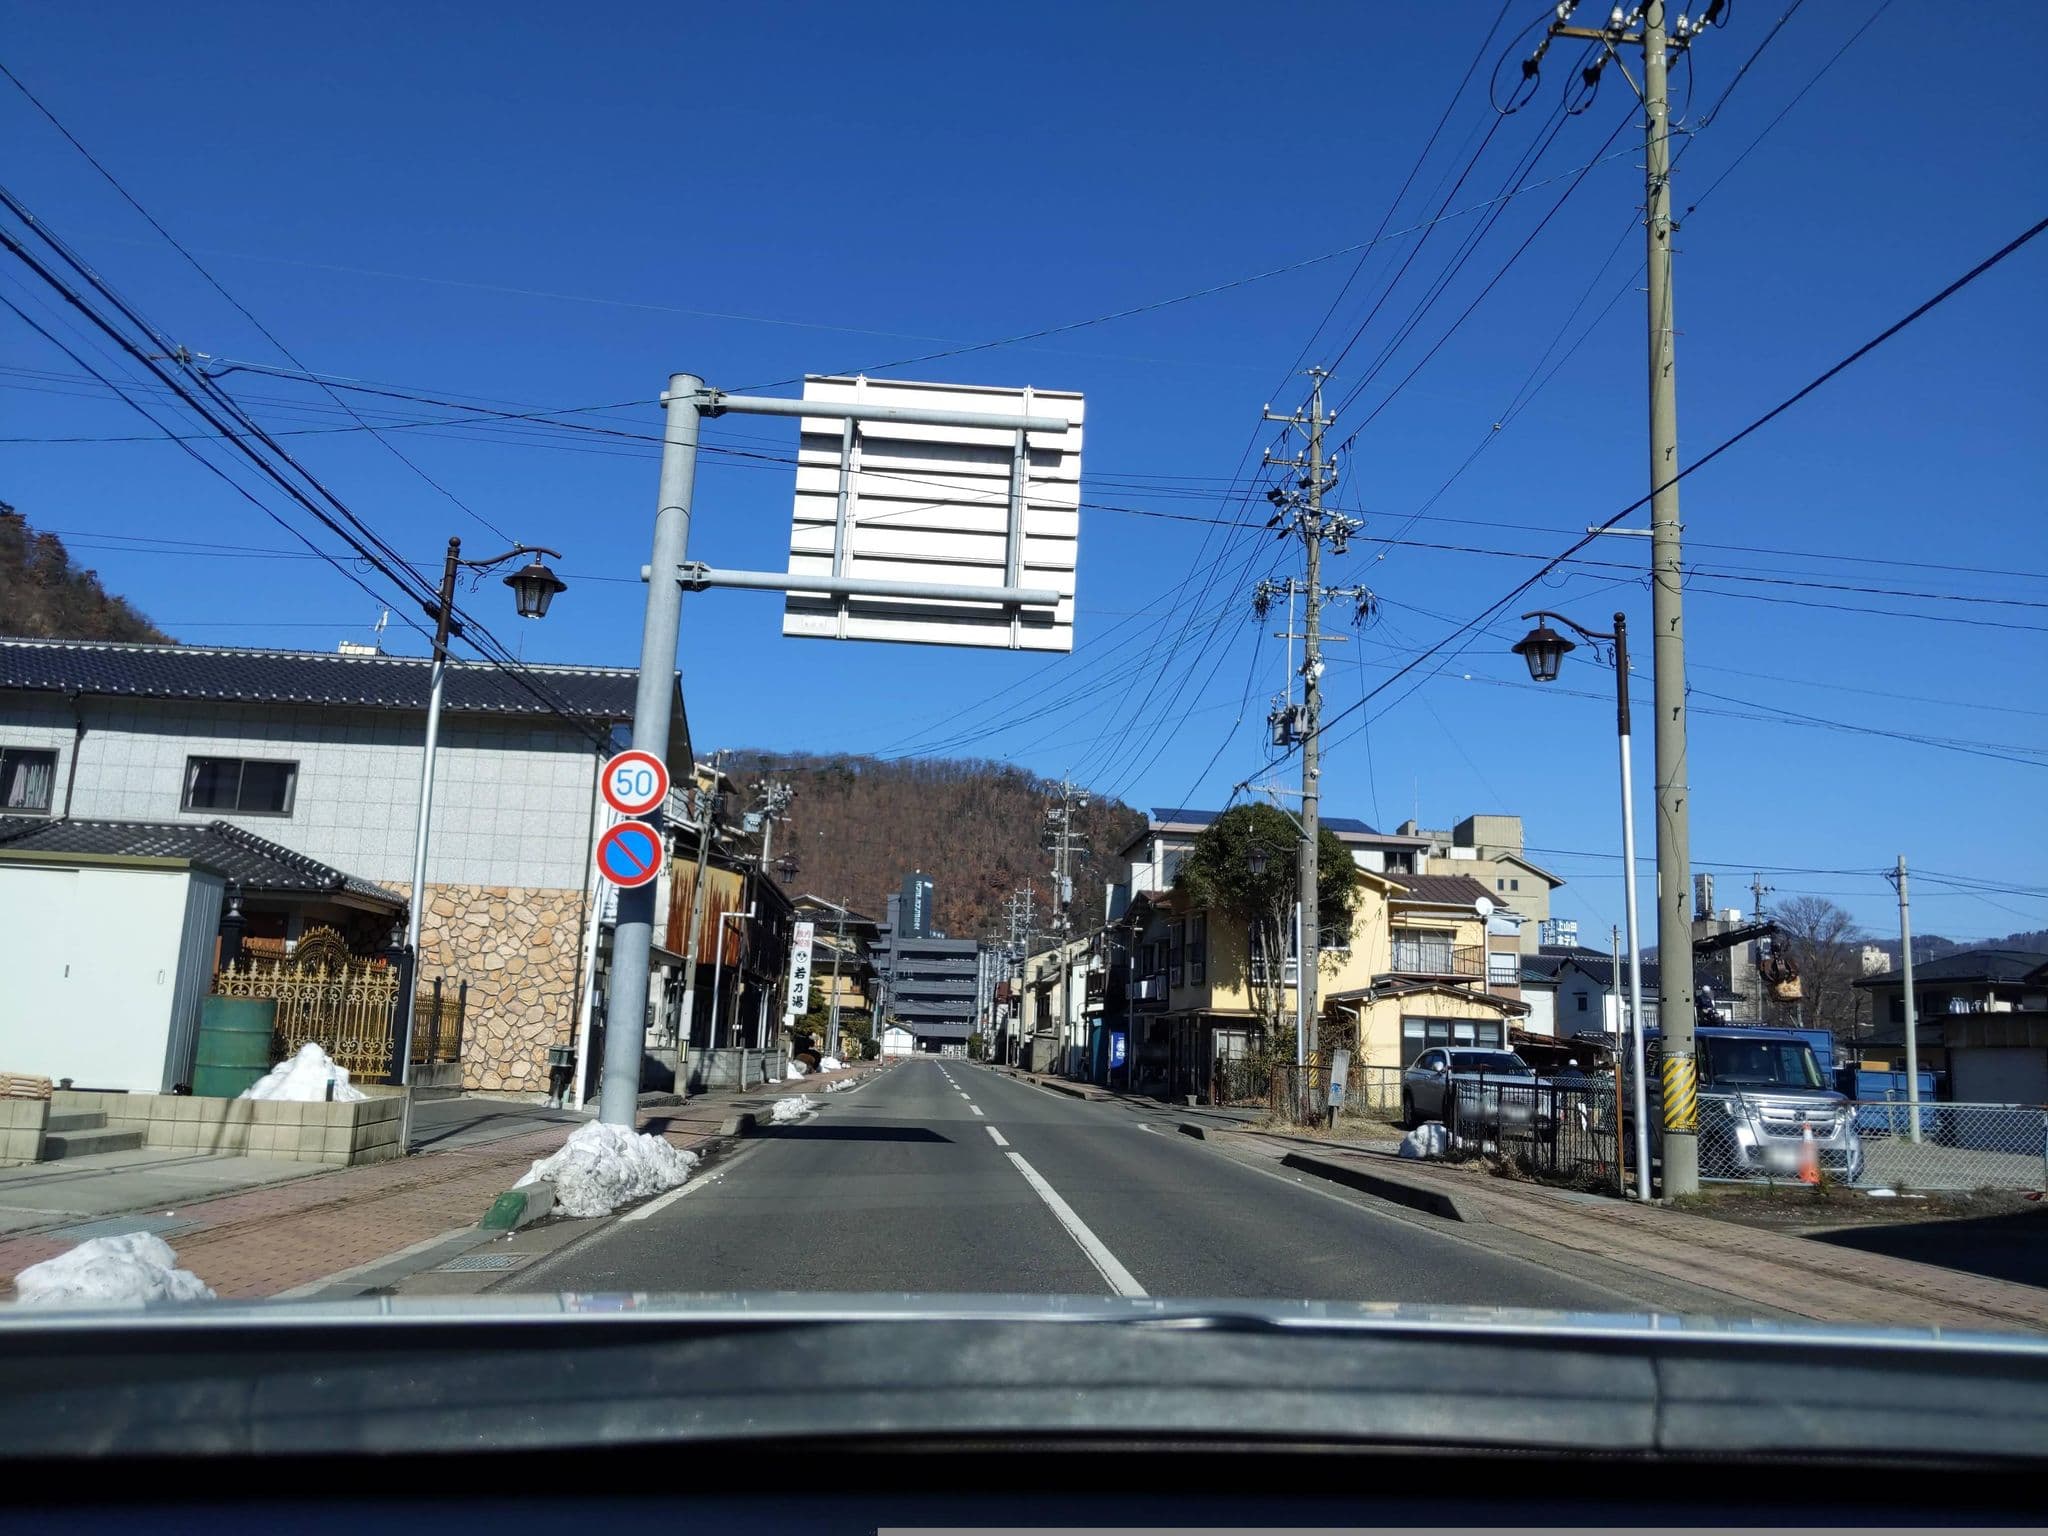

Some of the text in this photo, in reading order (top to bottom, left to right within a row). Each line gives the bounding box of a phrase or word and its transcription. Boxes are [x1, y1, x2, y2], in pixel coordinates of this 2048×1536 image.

[616, 769, 653, 797] 50
[792, 966, 807, 1009] 若乃湯
